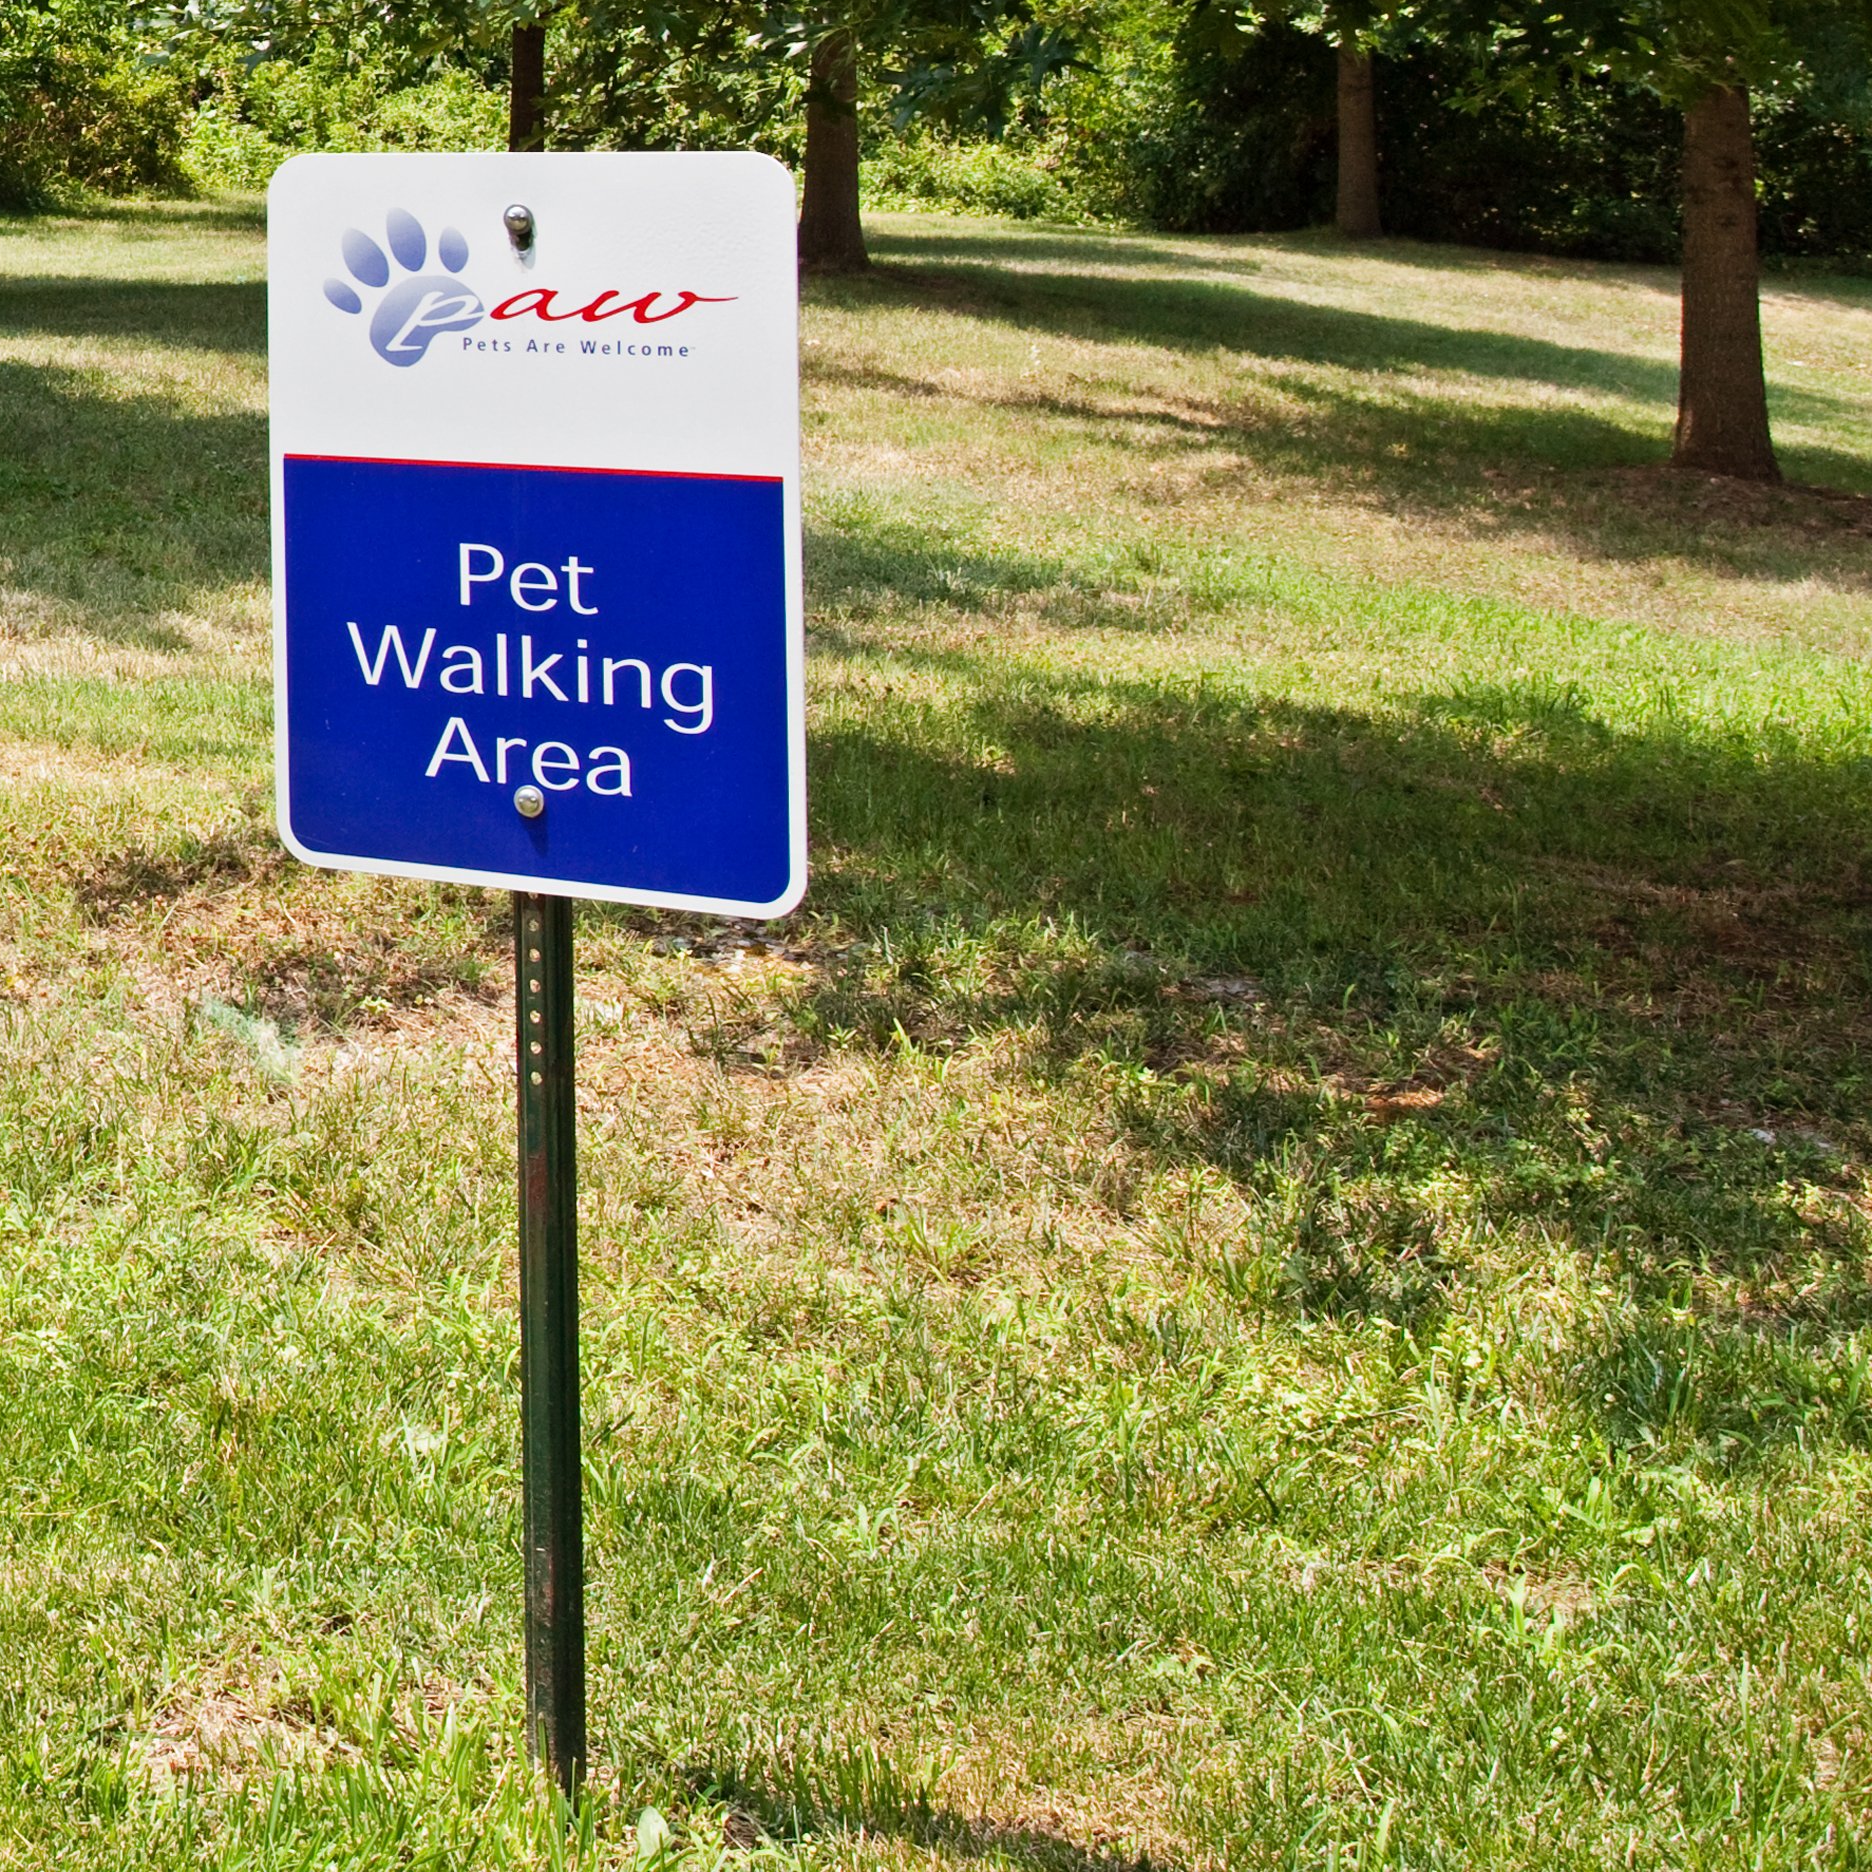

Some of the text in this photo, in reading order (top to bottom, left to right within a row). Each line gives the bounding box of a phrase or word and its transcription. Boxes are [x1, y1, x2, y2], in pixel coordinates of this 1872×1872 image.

[462, 337, 689, 357] Pets Are Welcome
[458, 542, 599, 616] Pet
[345, 621, 714, 735] Walking
[424, 716, 633, 798] Area
